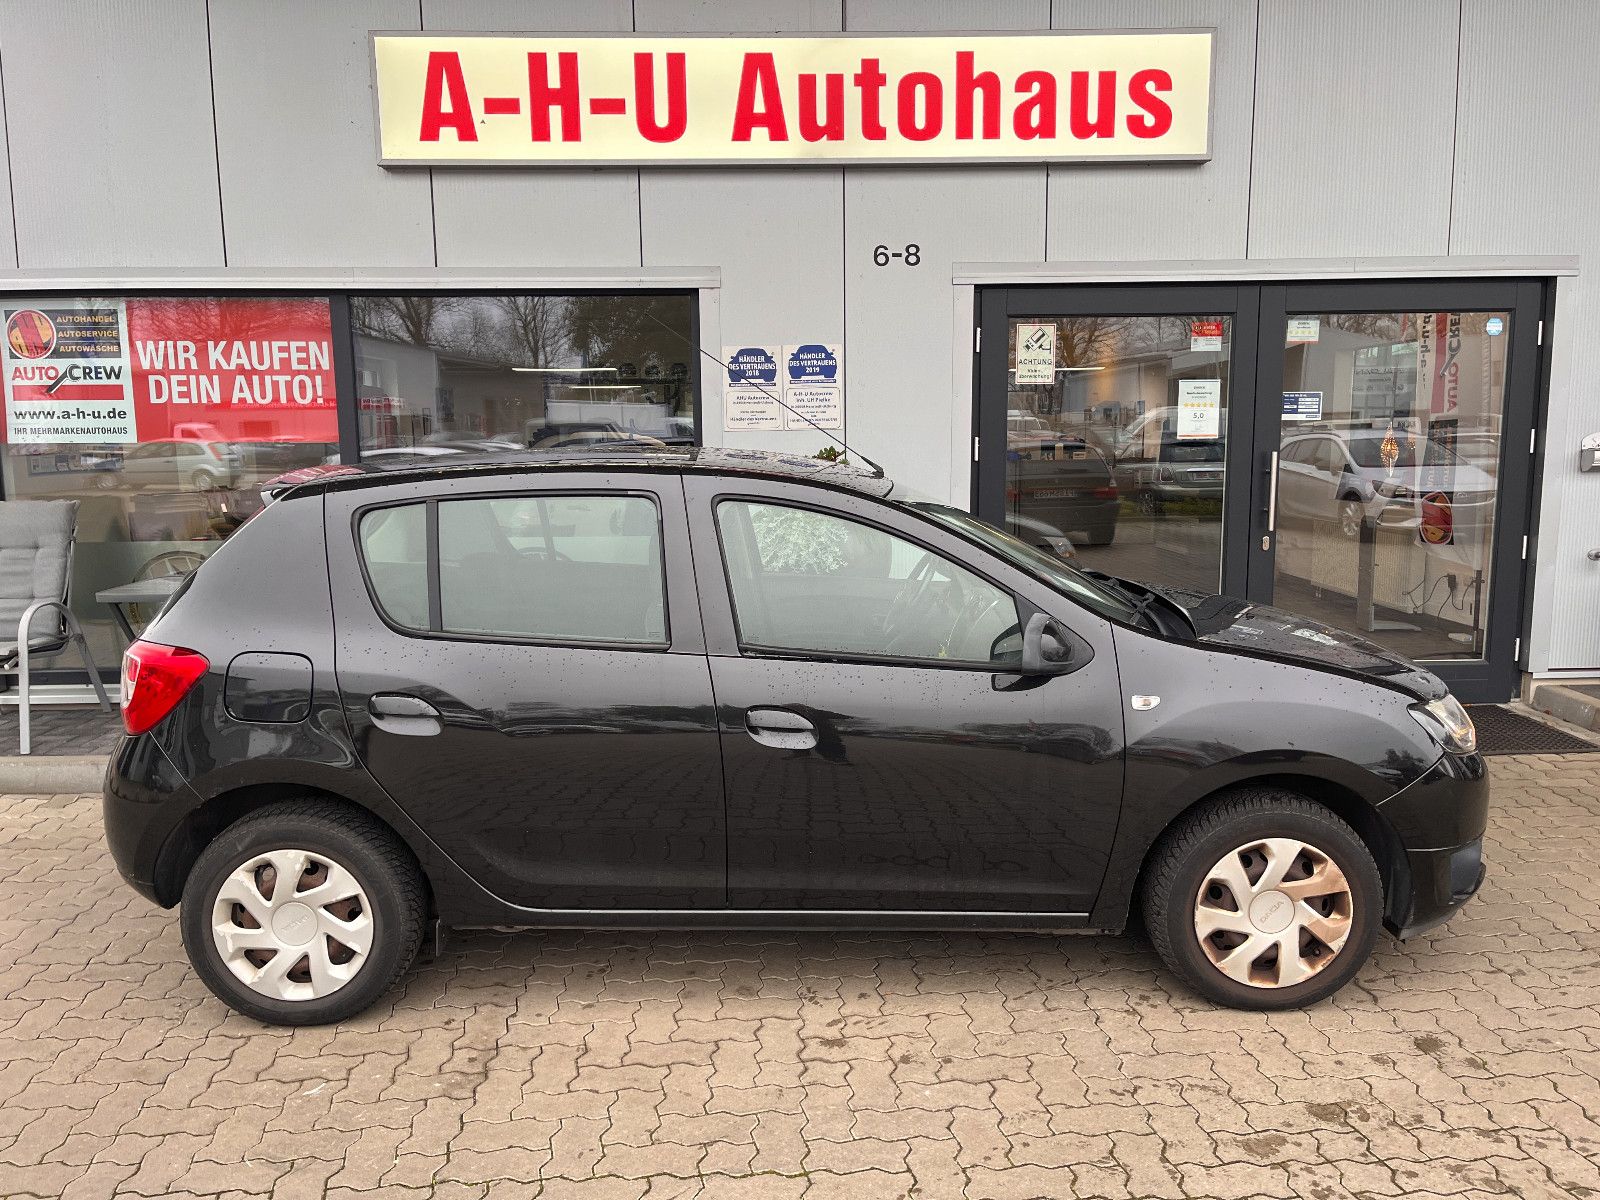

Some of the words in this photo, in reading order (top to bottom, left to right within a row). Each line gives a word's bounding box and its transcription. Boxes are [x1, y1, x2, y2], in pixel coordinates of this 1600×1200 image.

[419, 51, 687, 143] A-H-U
[731, 51, 1173, 142] Autohaus
[873, 244, 921, 267] 6-8
[56, 315, 115, 323] AUTOHANDEL
[57, 330, 119, 338] AUTOSERVICE
[136, 340, 198, 370] WIR
[207, 340, 330, 371] KAUFEN
[12, 366, 59, 380] AUTO
[67, 364, 122, 380] CREW
[148, 374, 221, 404] DEIN
[232, 374, 324, 405] AUTO!
[14, 407, 127, 420] www.a-h-u.de
[30, 427, 128, 435] MEHRMARKENAUTOHAUS
